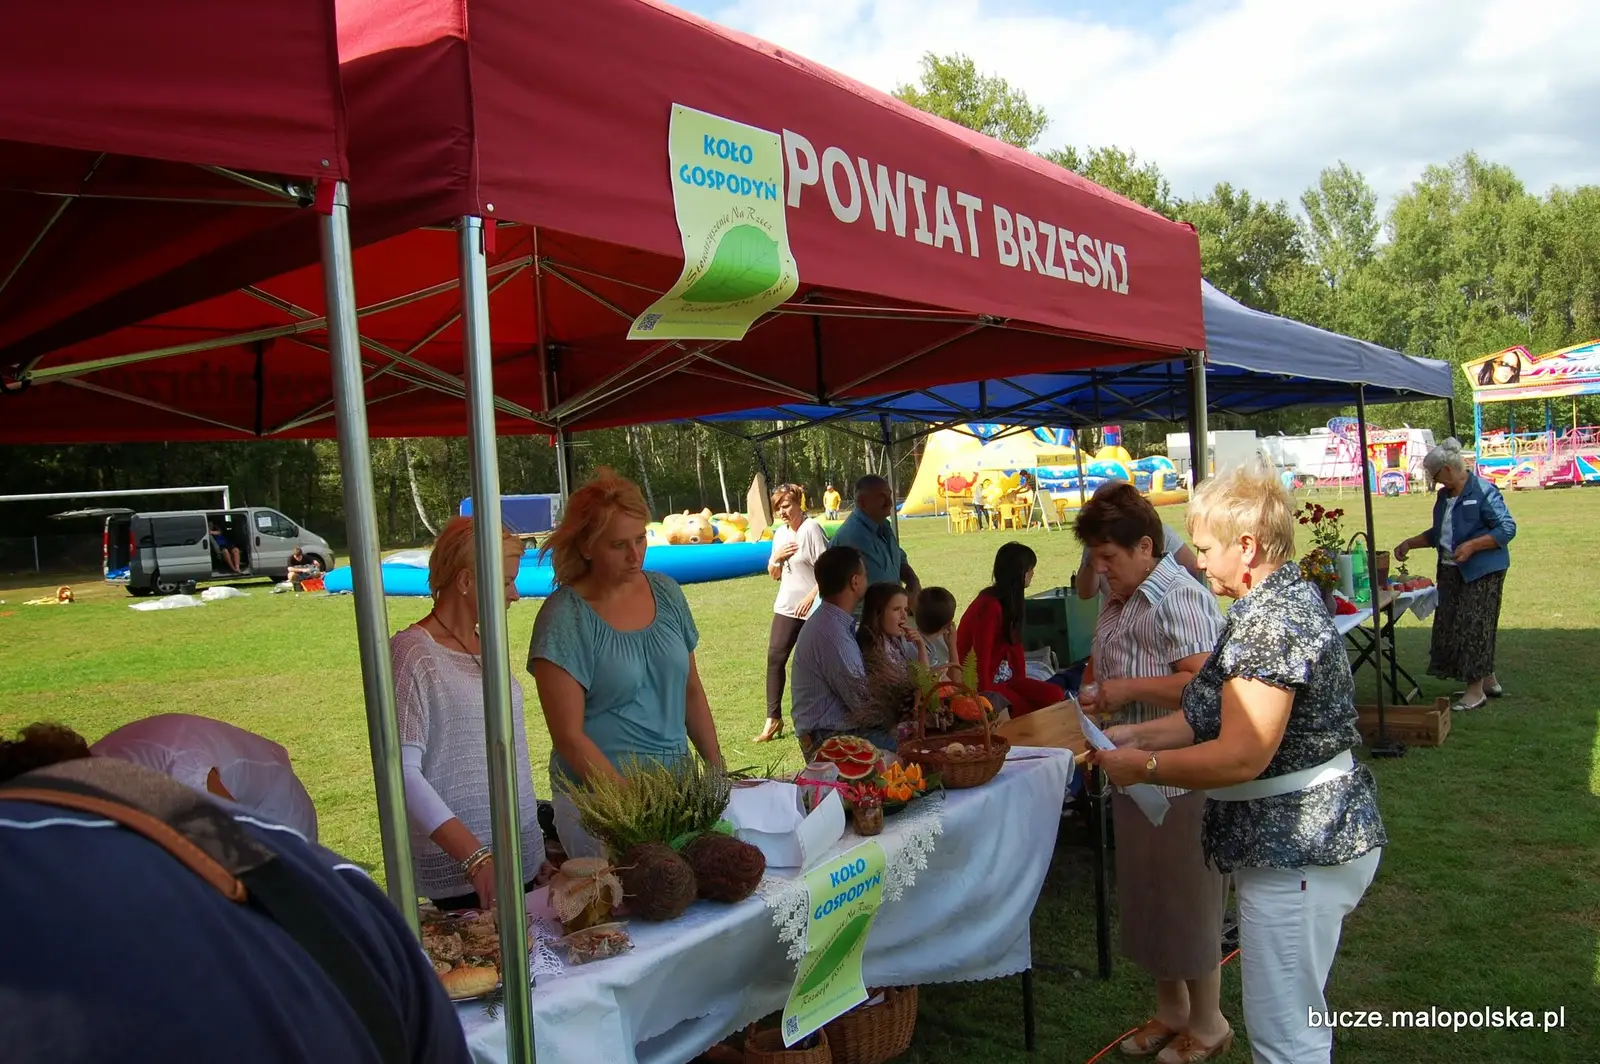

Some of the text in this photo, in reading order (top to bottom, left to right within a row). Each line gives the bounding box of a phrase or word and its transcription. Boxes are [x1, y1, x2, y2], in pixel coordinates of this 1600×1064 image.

[703, 134, 753, 165] KOŁO
[679, 163, 777, 202] GOSPODYŃ
[731, 205, 745, 223] Na
[746, 206, 773, 231] Rzecz
[782, 128, 1130, 295] POWIAT BRZESKI
[829, 858, 866, 888] KOŁO
[814, 870, 881, 920] GOSPODYŃ
